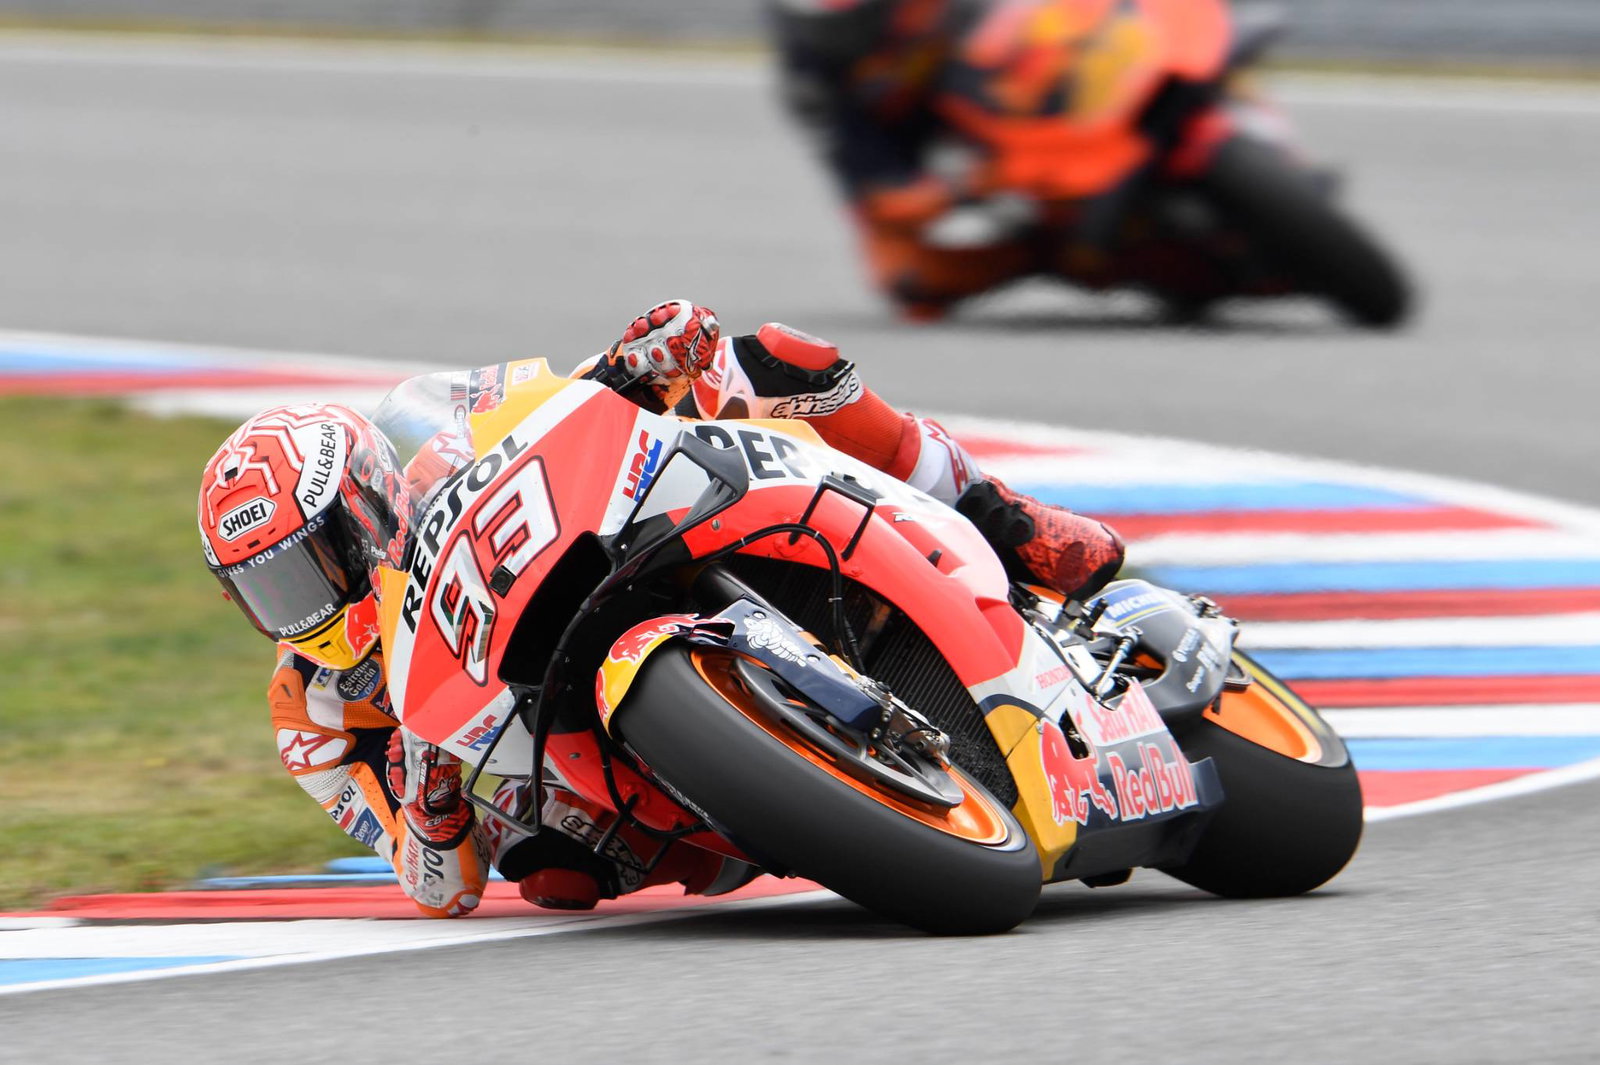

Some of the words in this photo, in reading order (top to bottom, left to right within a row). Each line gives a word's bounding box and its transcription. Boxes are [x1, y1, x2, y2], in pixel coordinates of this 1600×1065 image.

[303, 424, 336, 508] PULL&BEAR
[622, 429, 663, 503] HRC
[217, 564, 245, 578] GIVES
[247, 549, 275, 568] YOU
[278, 516, 325, 552] WINGS
[222, 502, 267, 537] SHOEI
[402, 435, 529, 635] REPSOL
[429, 455, 562, 688] 93
[279, 602, 337, 637] PULL&BEAR
[1106, 741, 1163, 822] Red
[1146, 735, 1199, 813] Bull
